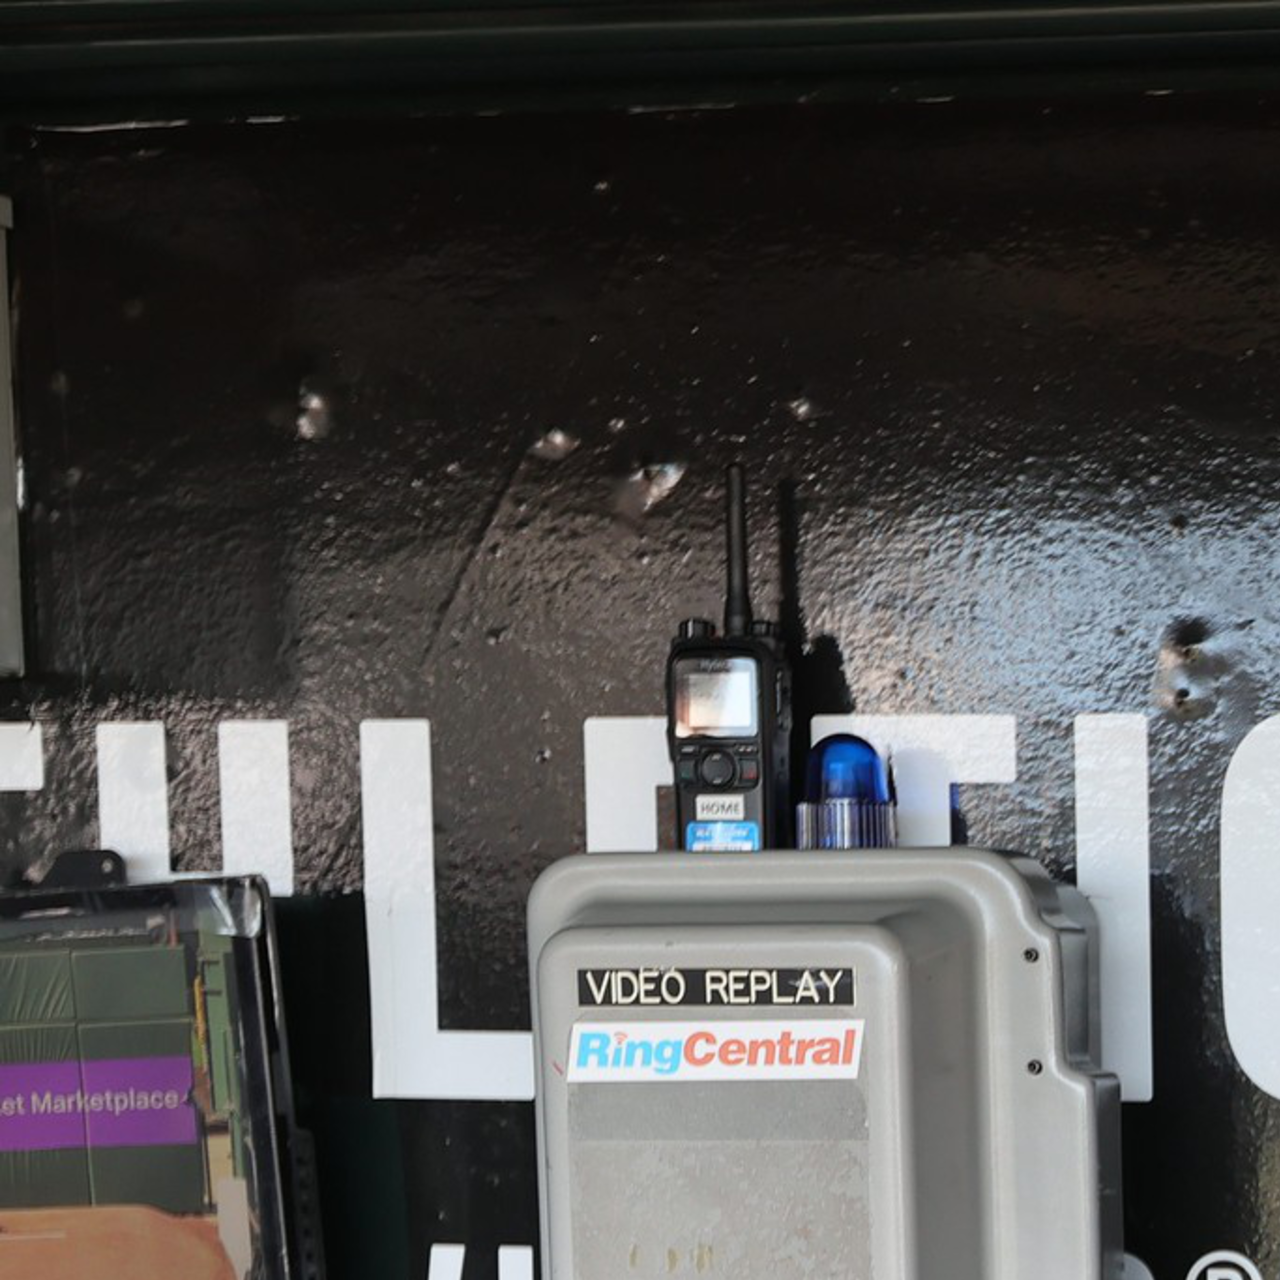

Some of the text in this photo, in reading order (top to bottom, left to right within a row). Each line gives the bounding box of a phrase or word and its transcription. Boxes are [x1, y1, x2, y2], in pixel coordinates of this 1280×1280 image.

[699, 801, 742, 817] HOME
[586, 969, 844, 1005] VIDEO REPLAY
[576, 1029, 856, 1075] RingCentral
[0, 1087, 179, 1117] et Marketplace
